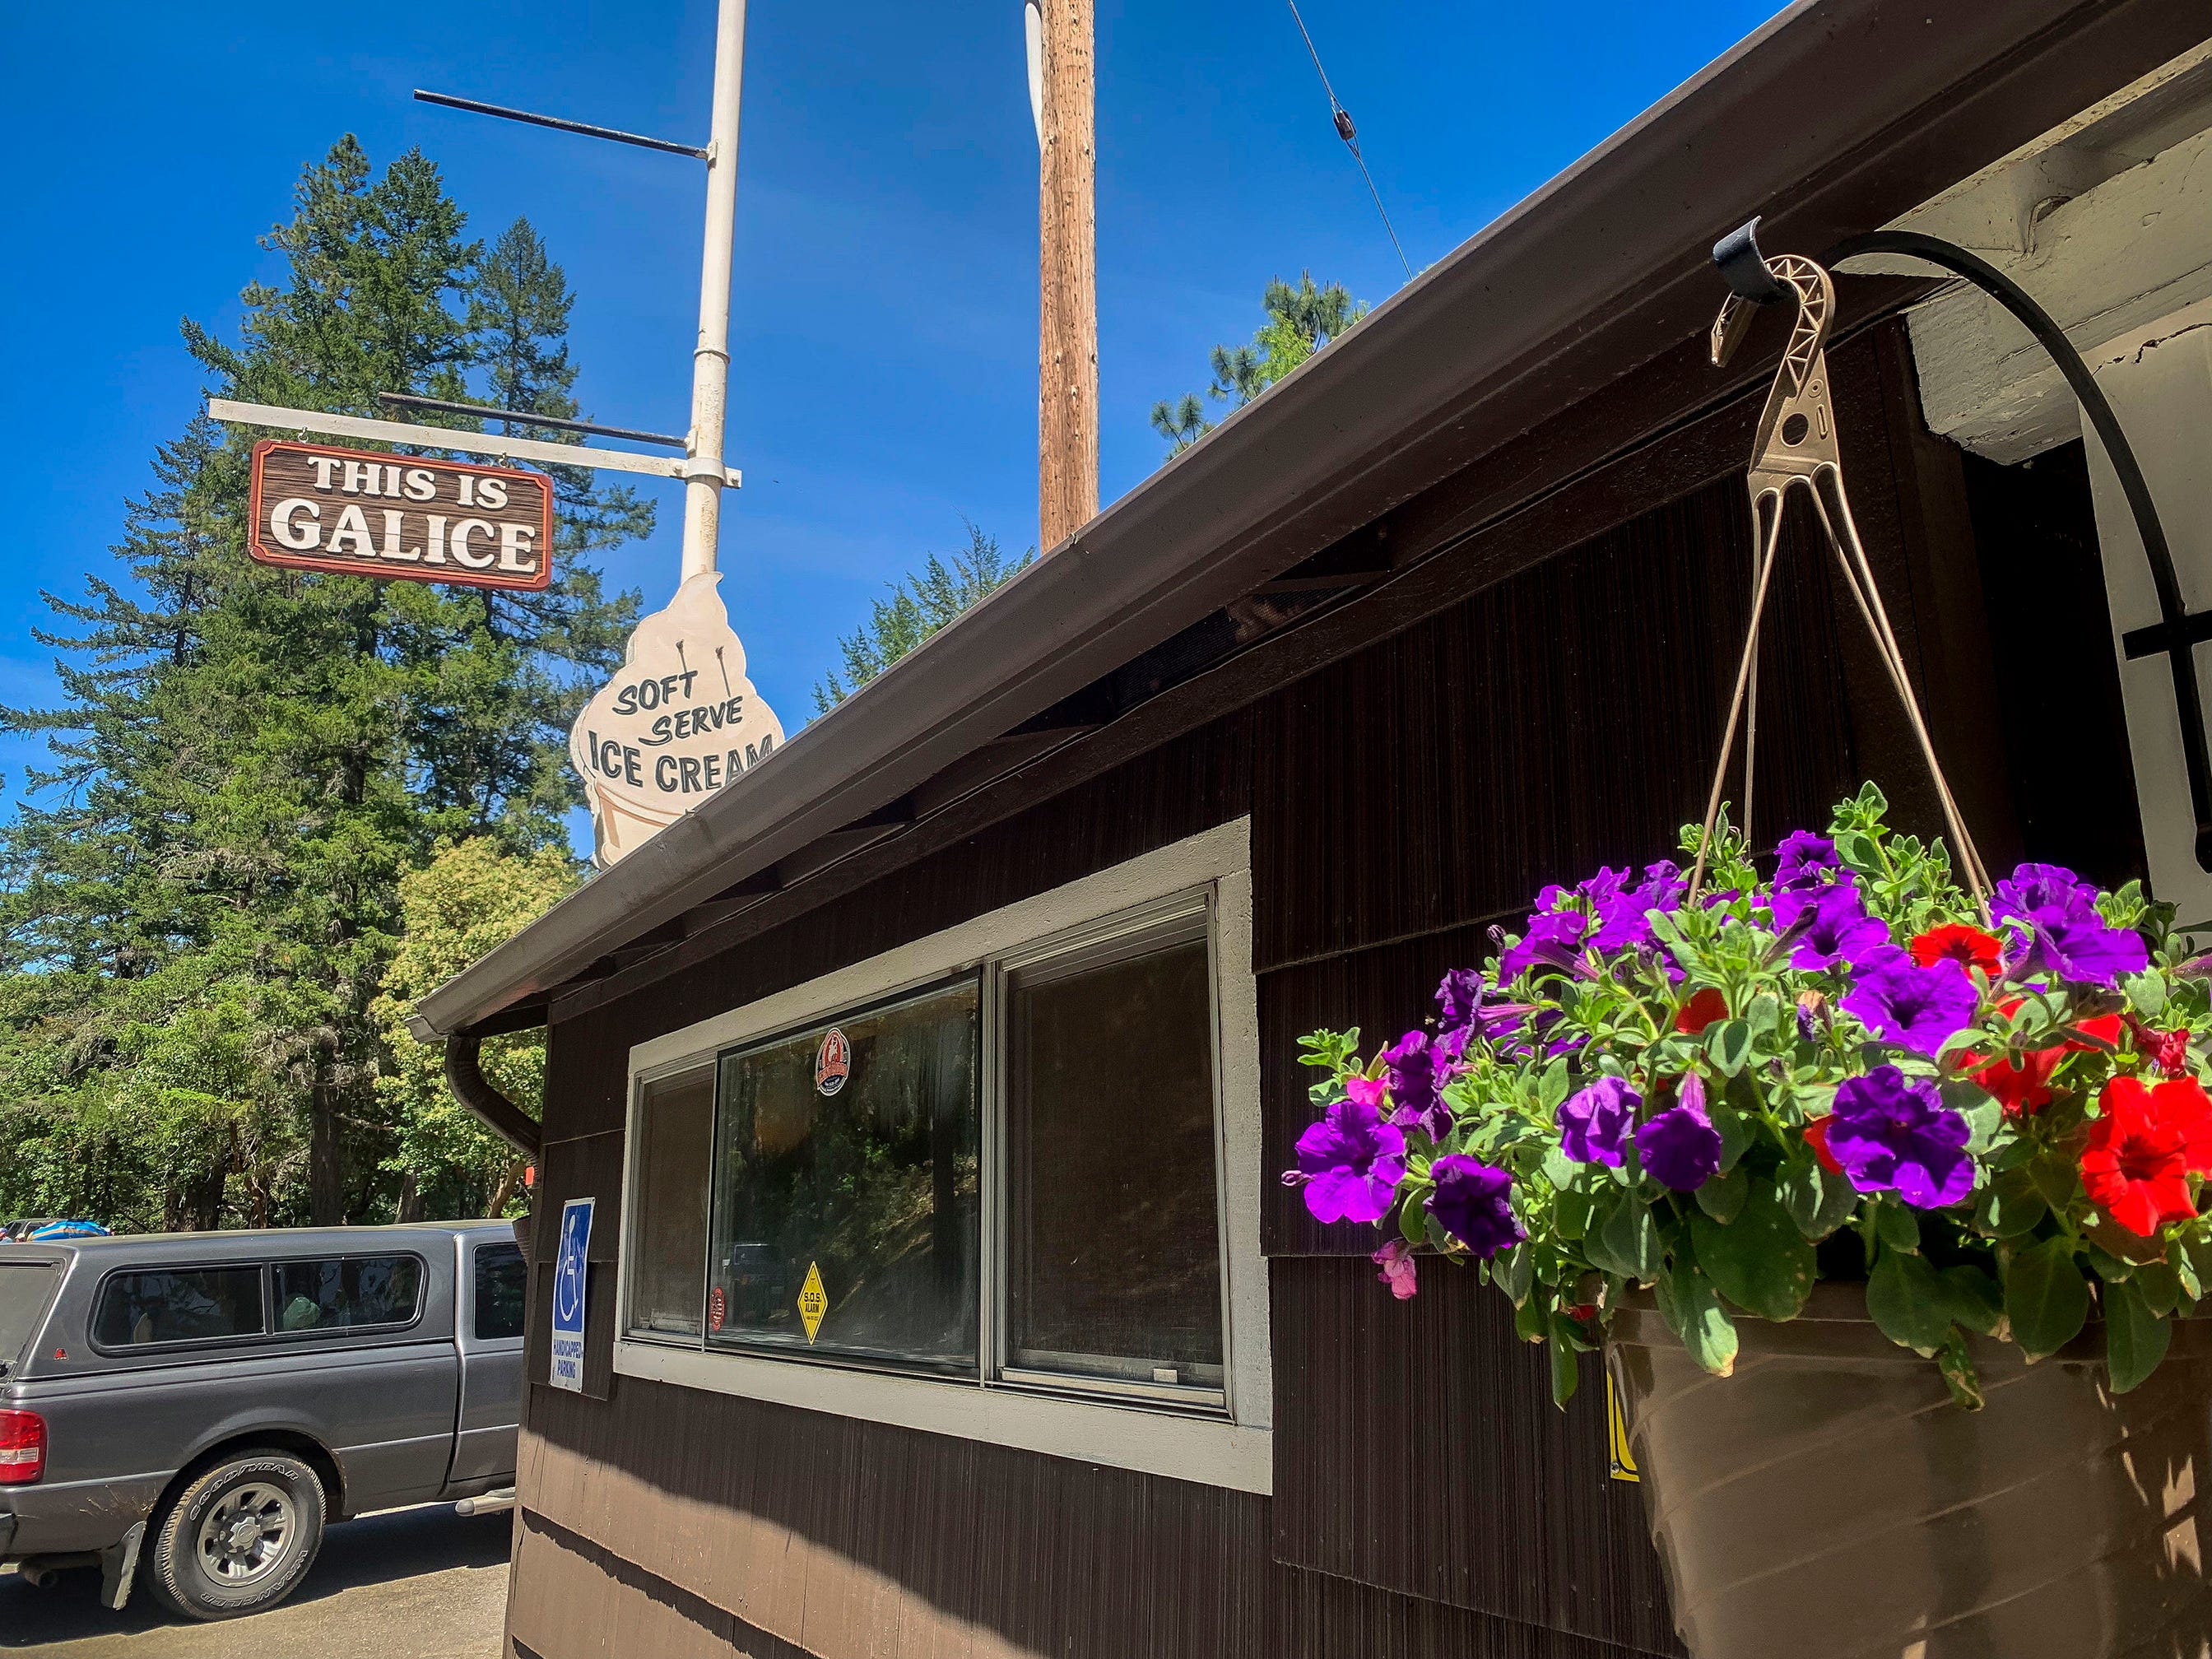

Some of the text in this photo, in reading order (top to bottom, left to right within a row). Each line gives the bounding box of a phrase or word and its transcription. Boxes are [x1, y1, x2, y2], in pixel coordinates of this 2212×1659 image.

[308, 457, 509, 509] THIS IS
[270, 498, 537, 574] GALICE
[612, 670, 698, 715] SOFT
[639, 695, 743, 746] SERVE
[588, 731, 644, 788] ICE
[804, 1292, 821, 1303] S.O.S.
[805, 1303, 820, 1313] ALARM
[553, 1339, 581, 1359] HANDICAPPED
[557, 1359, 575, 1378] PARKING
[189, 1462, 300, 1521] GOODYEAR
[200, 1550, 309, 1607] WRANGLER
